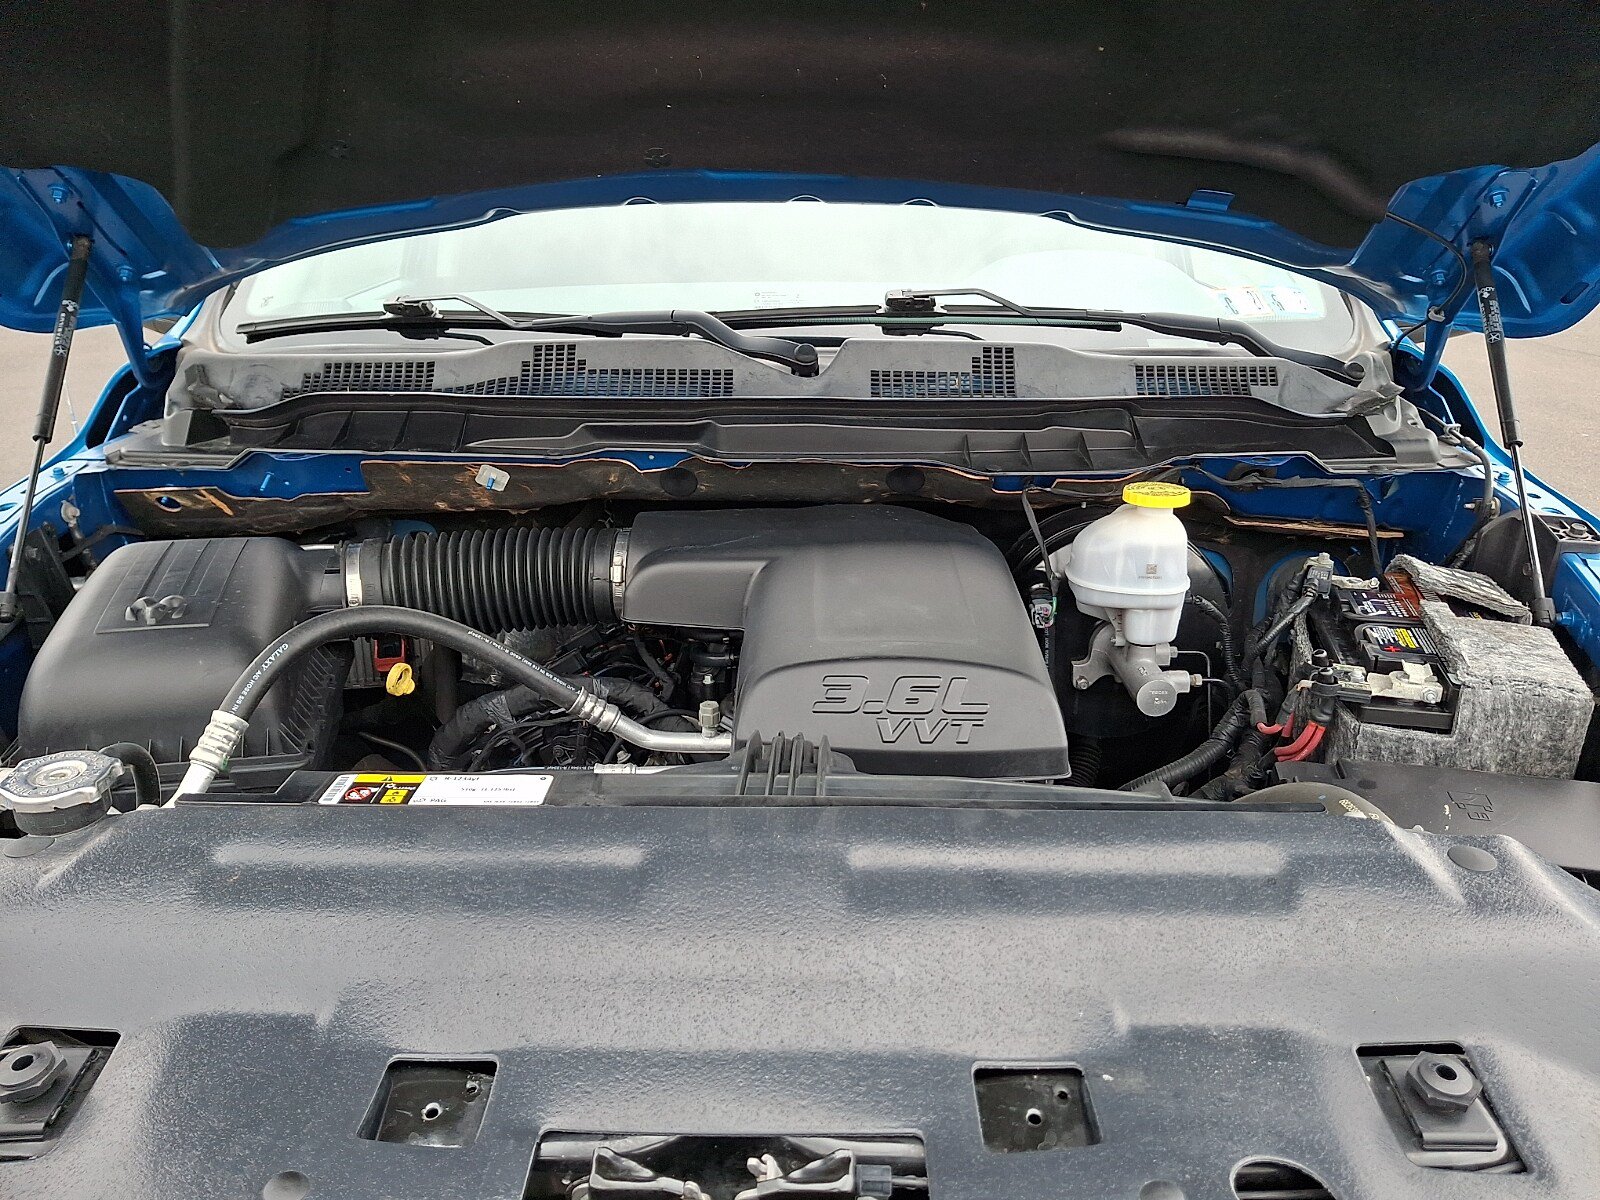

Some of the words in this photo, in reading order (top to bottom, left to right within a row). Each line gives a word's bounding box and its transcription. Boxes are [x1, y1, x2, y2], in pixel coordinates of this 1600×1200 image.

[261, 643, 289, 671] GALAXY
[241, 680, 255, 696] HOSE
[252, 670, 262, 680] A/C
[811, 674, 990, 715] 3.6L
[876, 717, 986, 744] VVT
